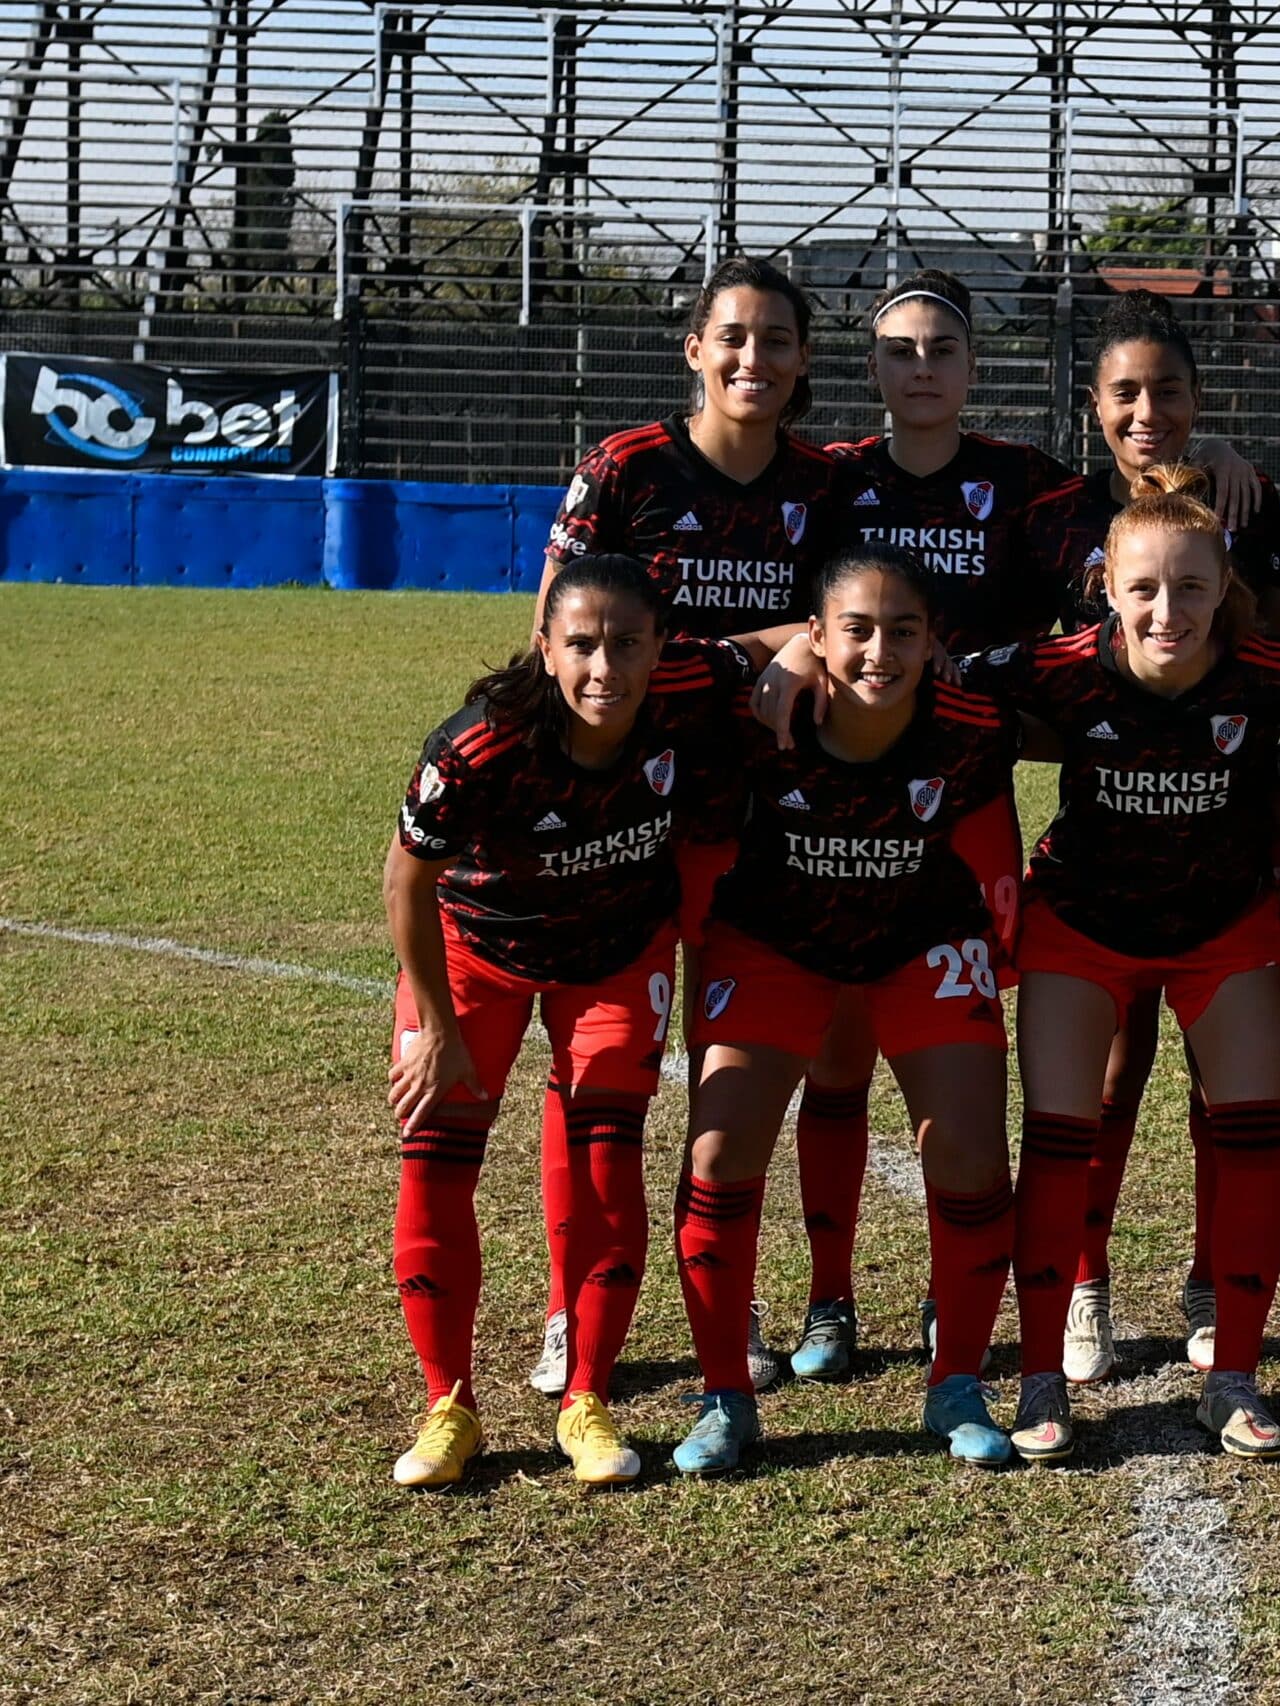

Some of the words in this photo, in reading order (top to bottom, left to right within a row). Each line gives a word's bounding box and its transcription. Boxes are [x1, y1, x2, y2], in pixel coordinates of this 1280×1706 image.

[166, 378, 300, 448] bet
[673, 523, 703, 531] adidas
[677, 557, 794, 585] TURKISH
[672, 585, 792, 610] AIRLINES
[1086, 731, 1119, 740] adidas
[1095, 766, 1230, 793] TURKISH
[779, 799, 811, 811] adidas
[1095, 789, 1228, 815] AIRLINES
[539, 810, 672, 867] TURKISH
[785, 832, 924, 859] TURKISH
[786, 854, 922, 878] AIRLINES
[926, 938, 997, 999] 28
[648, 972, 670, 1041] 9
